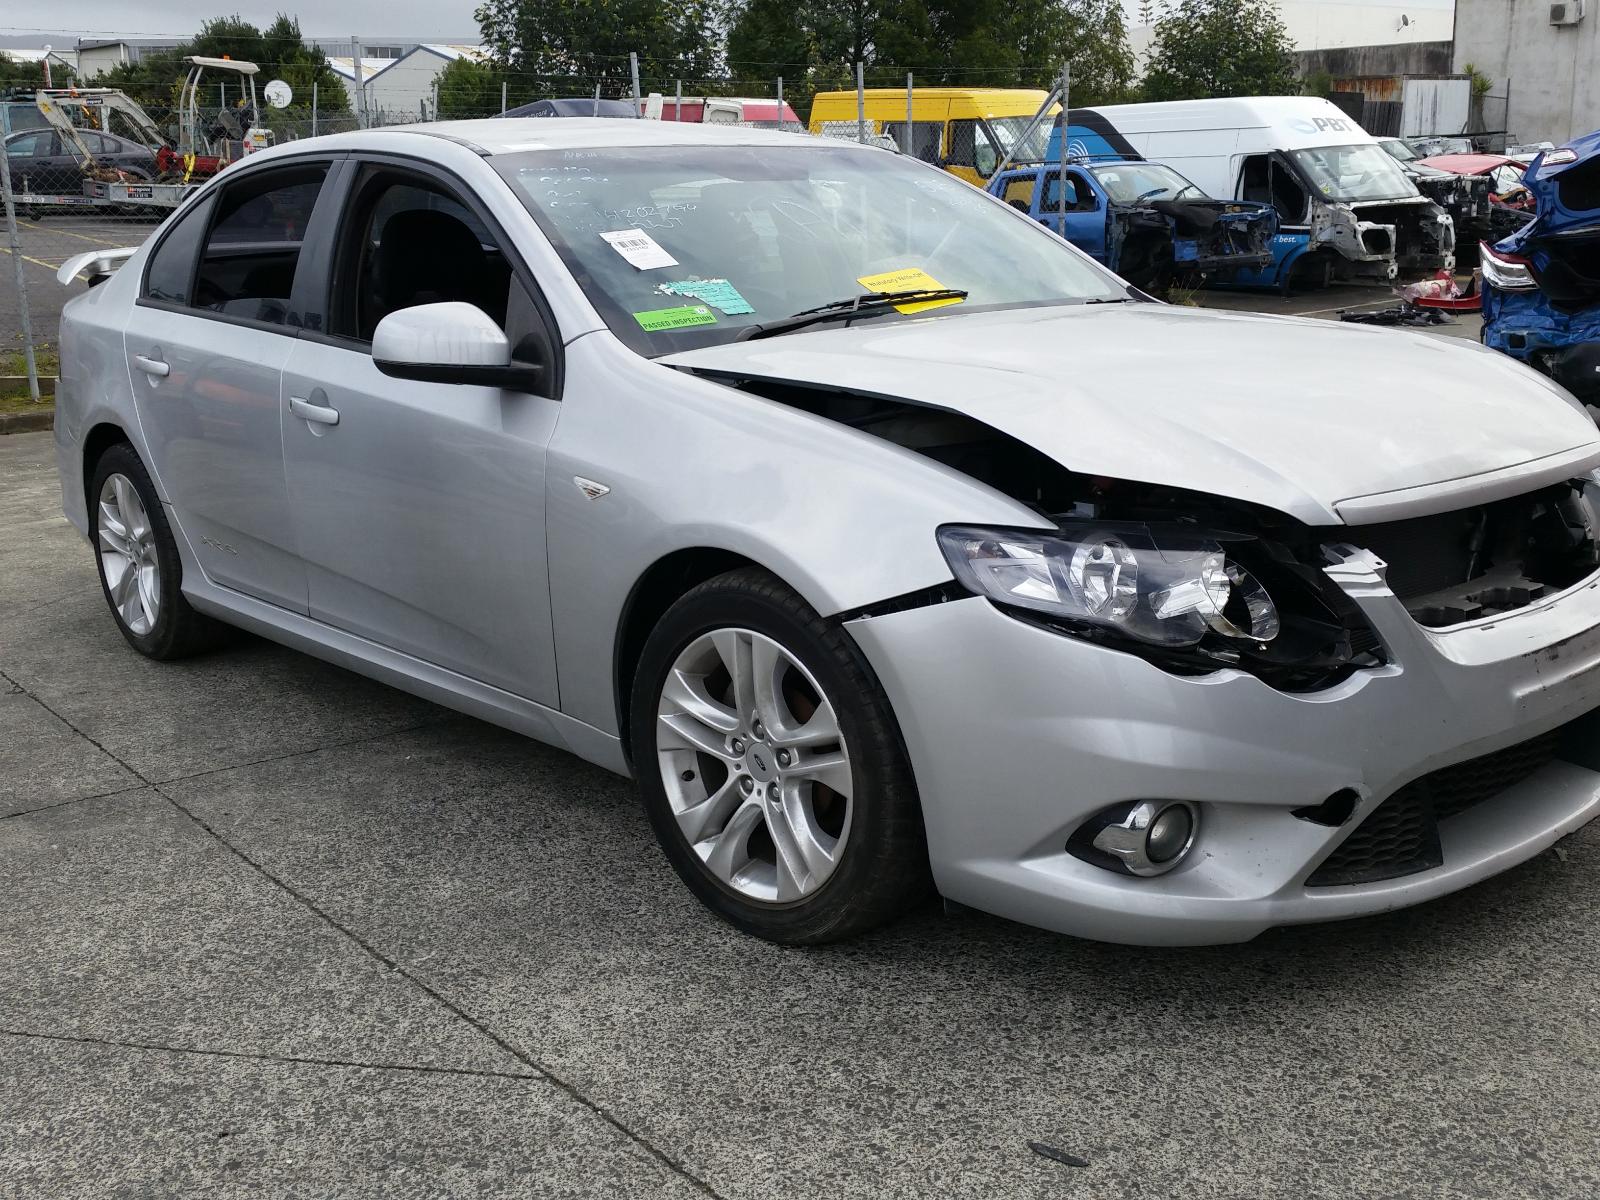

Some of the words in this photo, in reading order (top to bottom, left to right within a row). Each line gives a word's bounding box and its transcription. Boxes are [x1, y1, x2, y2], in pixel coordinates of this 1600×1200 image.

[1312, 117, 1352, 131] PBT
[643, 321, 671, 330] PASSED
[672, 315, 714, 326] INSPECTION
